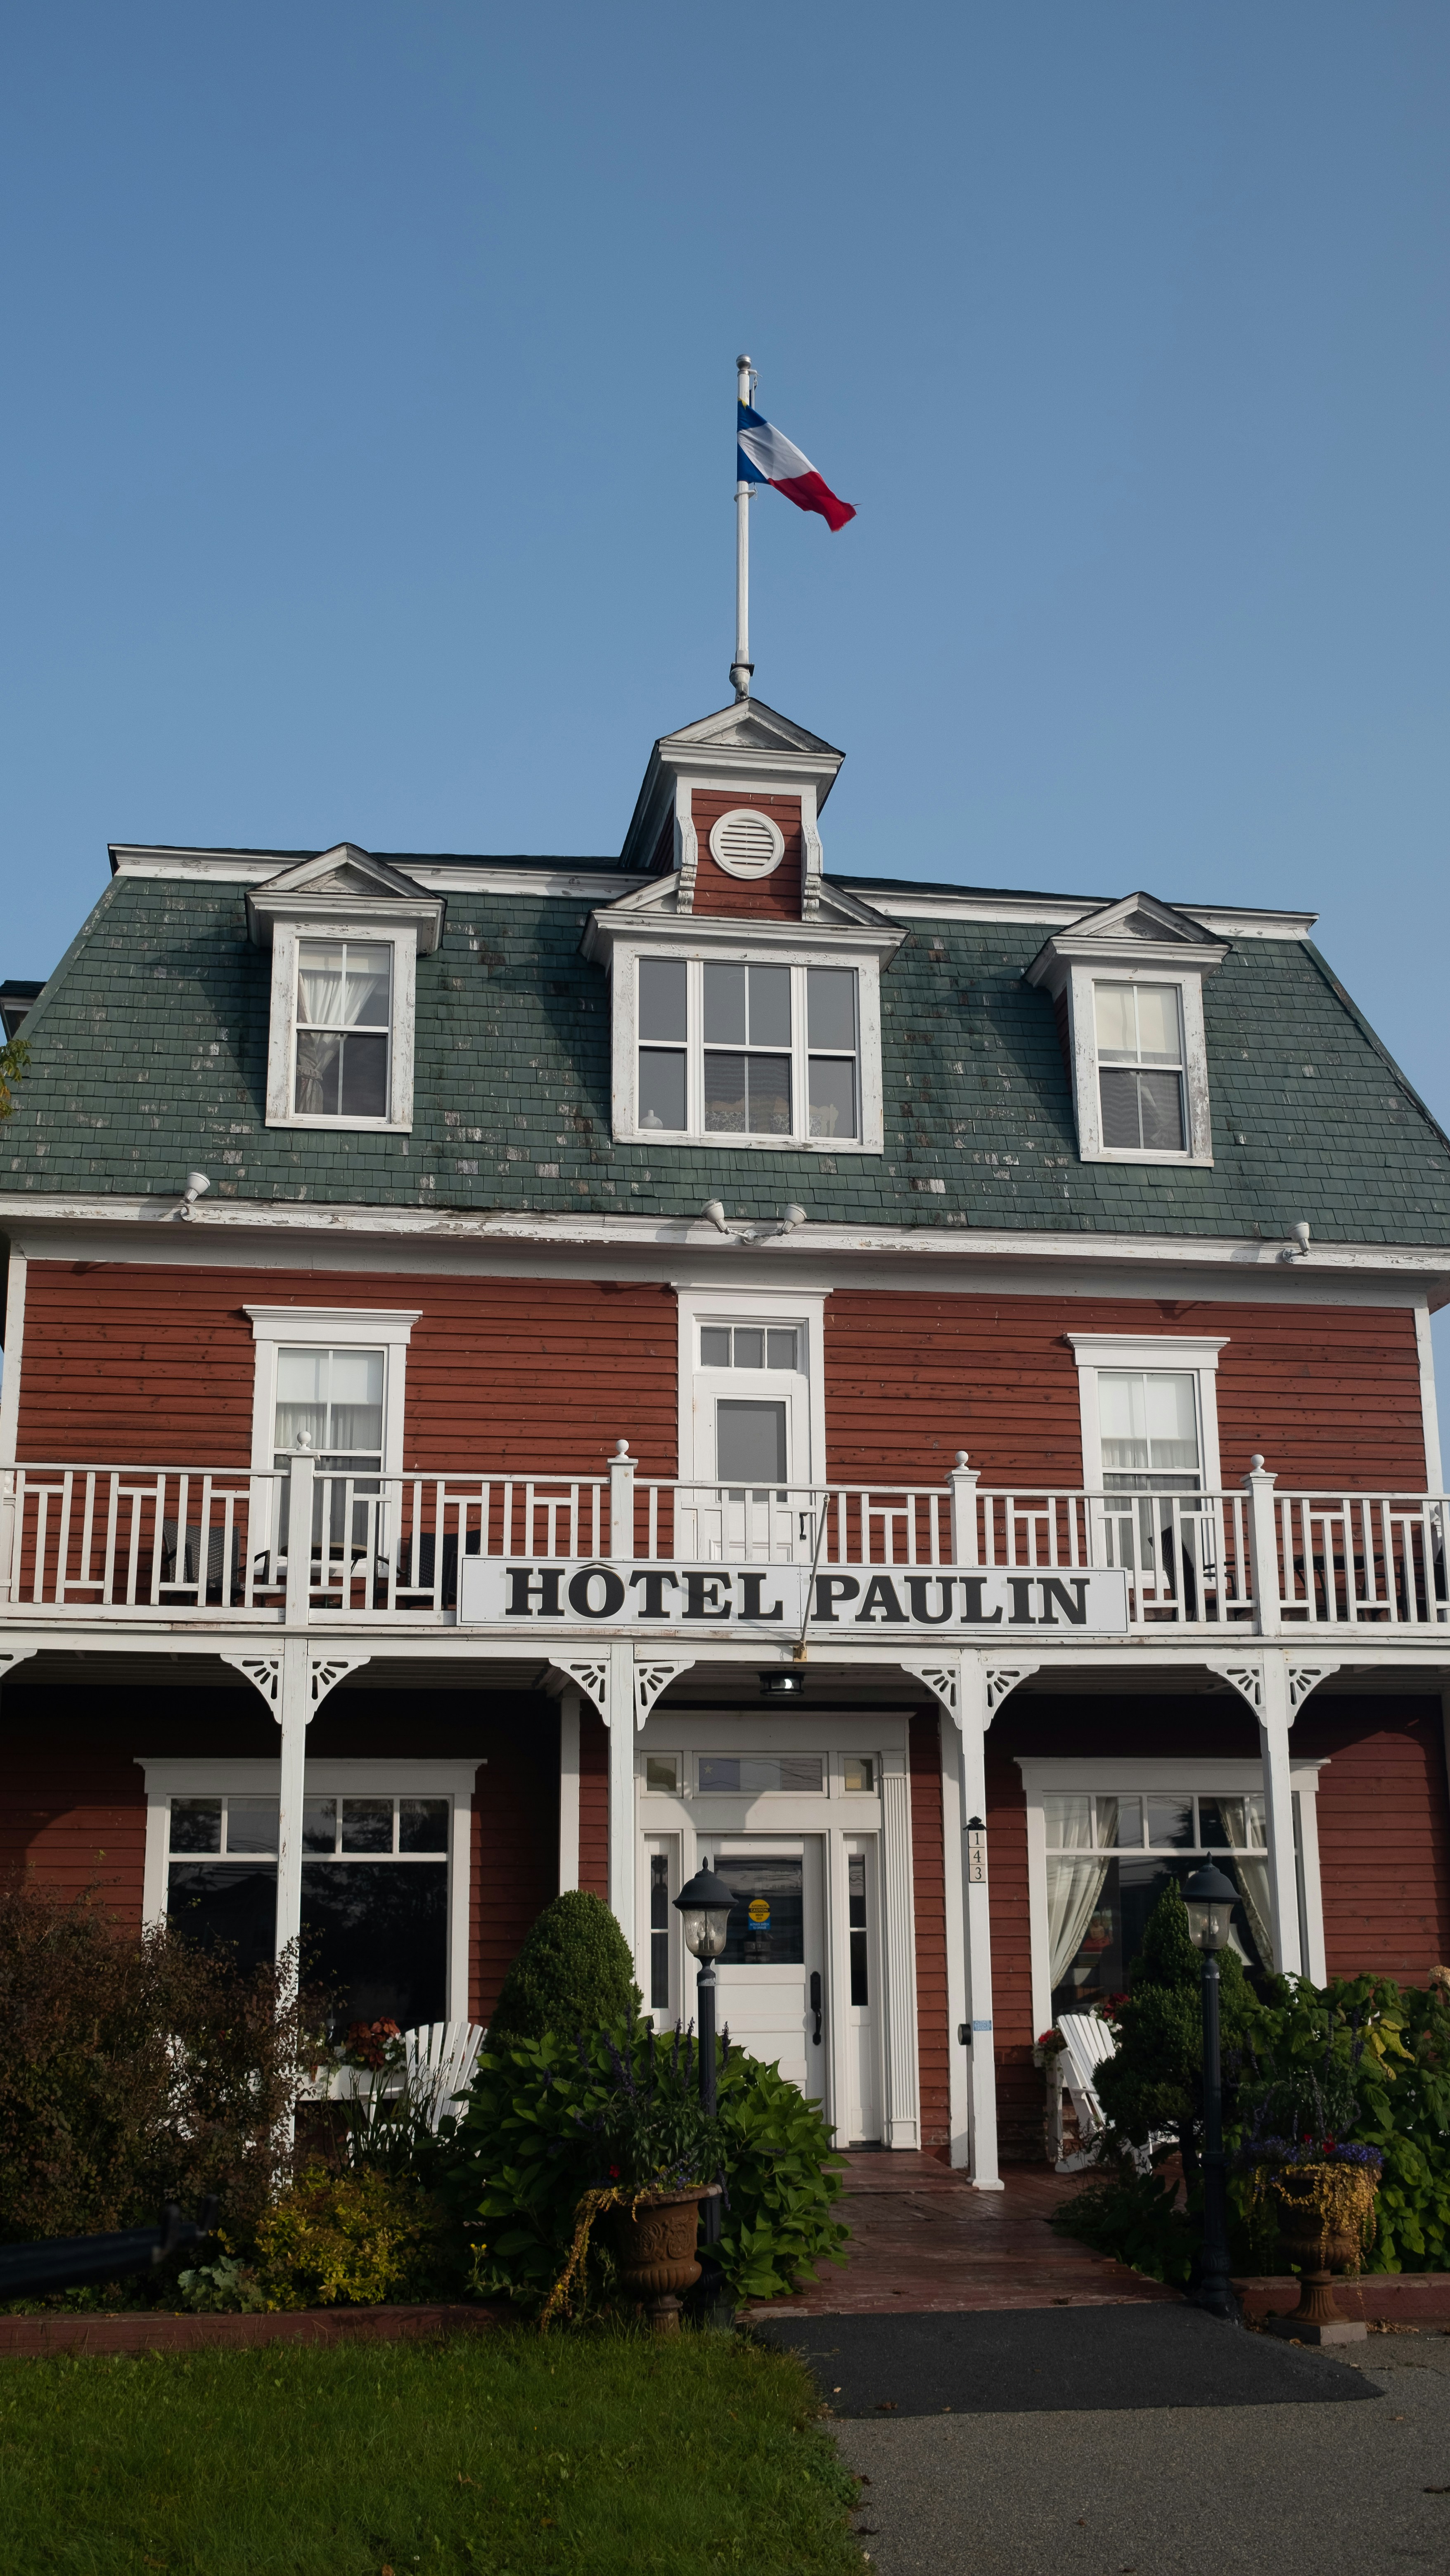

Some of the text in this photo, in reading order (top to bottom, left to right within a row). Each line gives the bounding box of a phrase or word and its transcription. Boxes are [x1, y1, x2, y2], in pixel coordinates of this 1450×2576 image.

[505, 1562, 1090, 1625] HÔTEL PAULIN
[973, 1832, 982, 1880] 143
